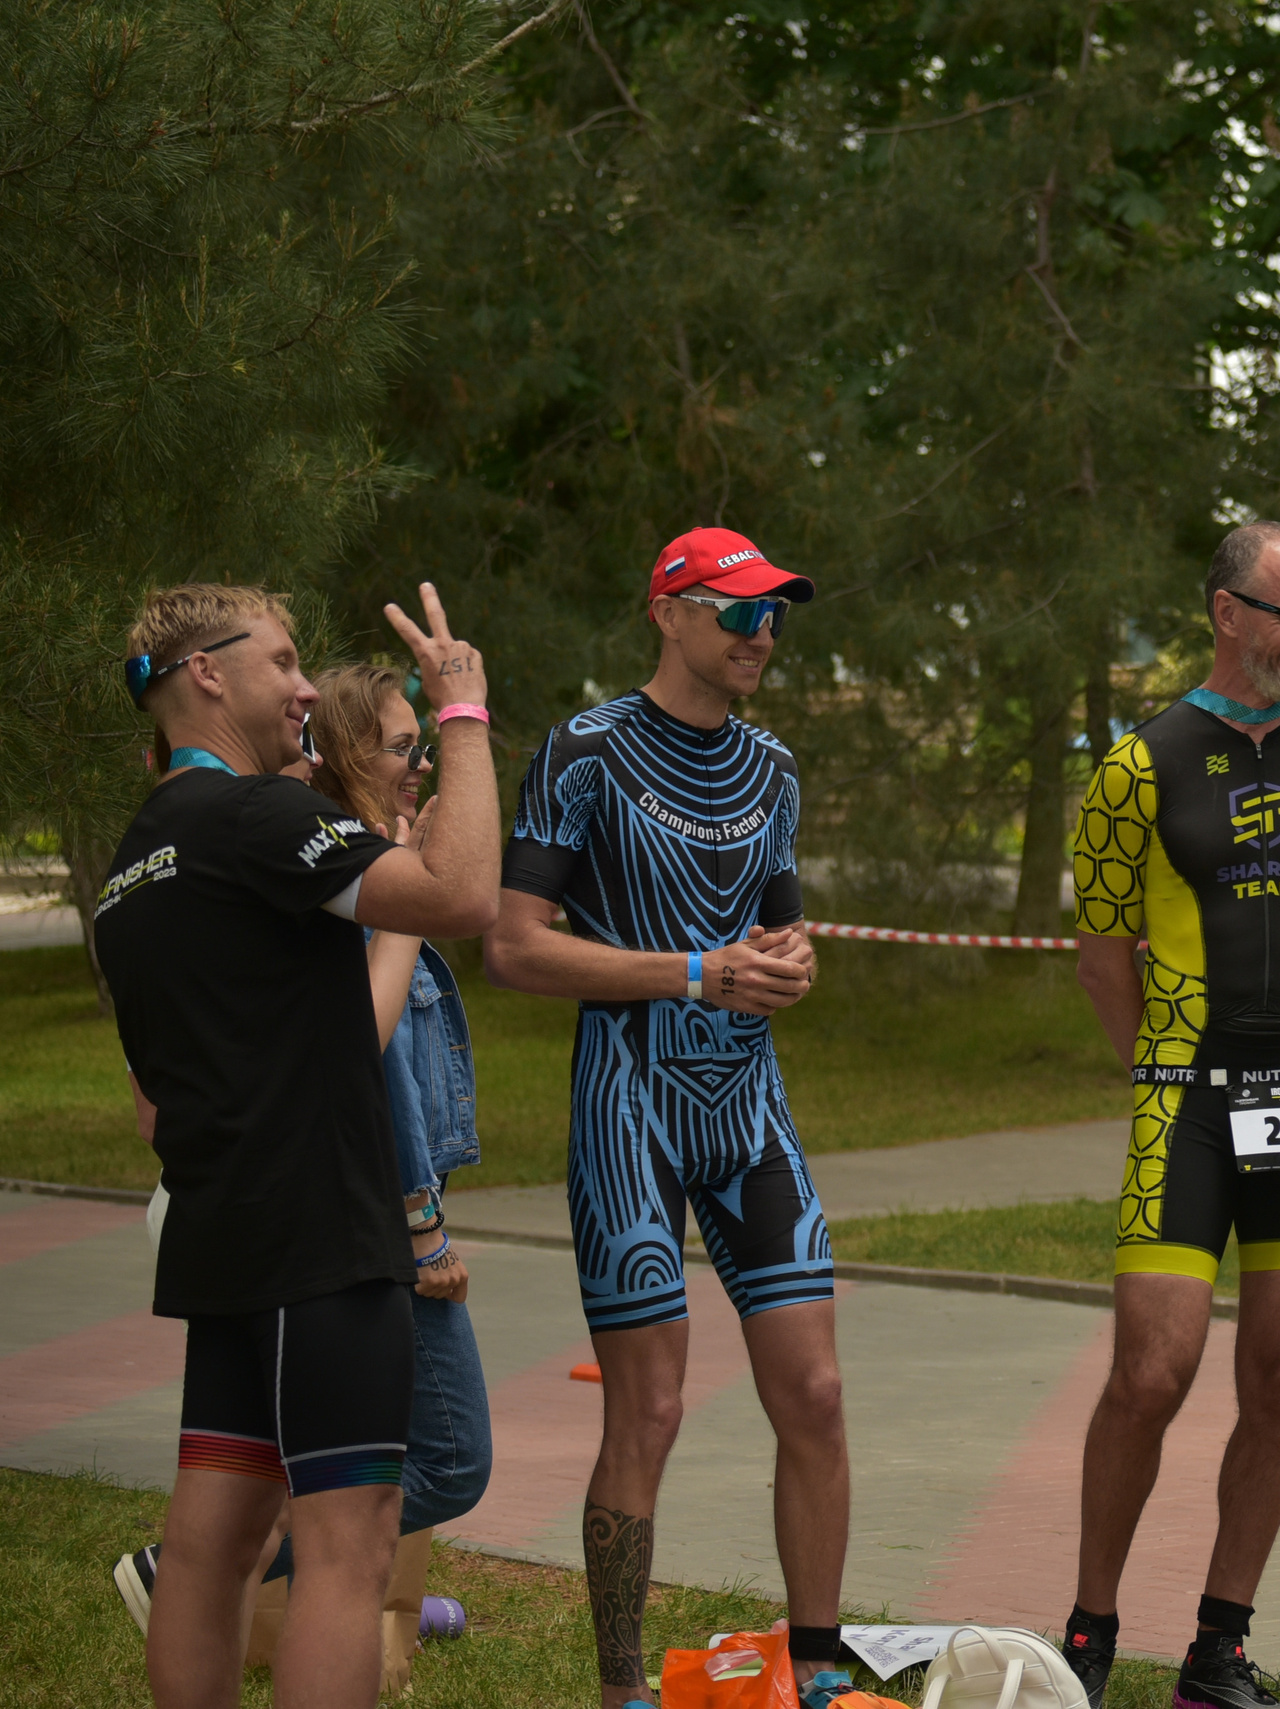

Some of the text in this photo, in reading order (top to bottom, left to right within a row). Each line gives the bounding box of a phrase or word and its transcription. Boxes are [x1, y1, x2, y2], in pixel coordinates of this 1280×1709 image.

[638, 791, 768, 842] Champions Factory
[105, 845, 177, 900] FINISHER
[153, 866, 177, 882] 2023
[721, 965, 736, 996] 182
